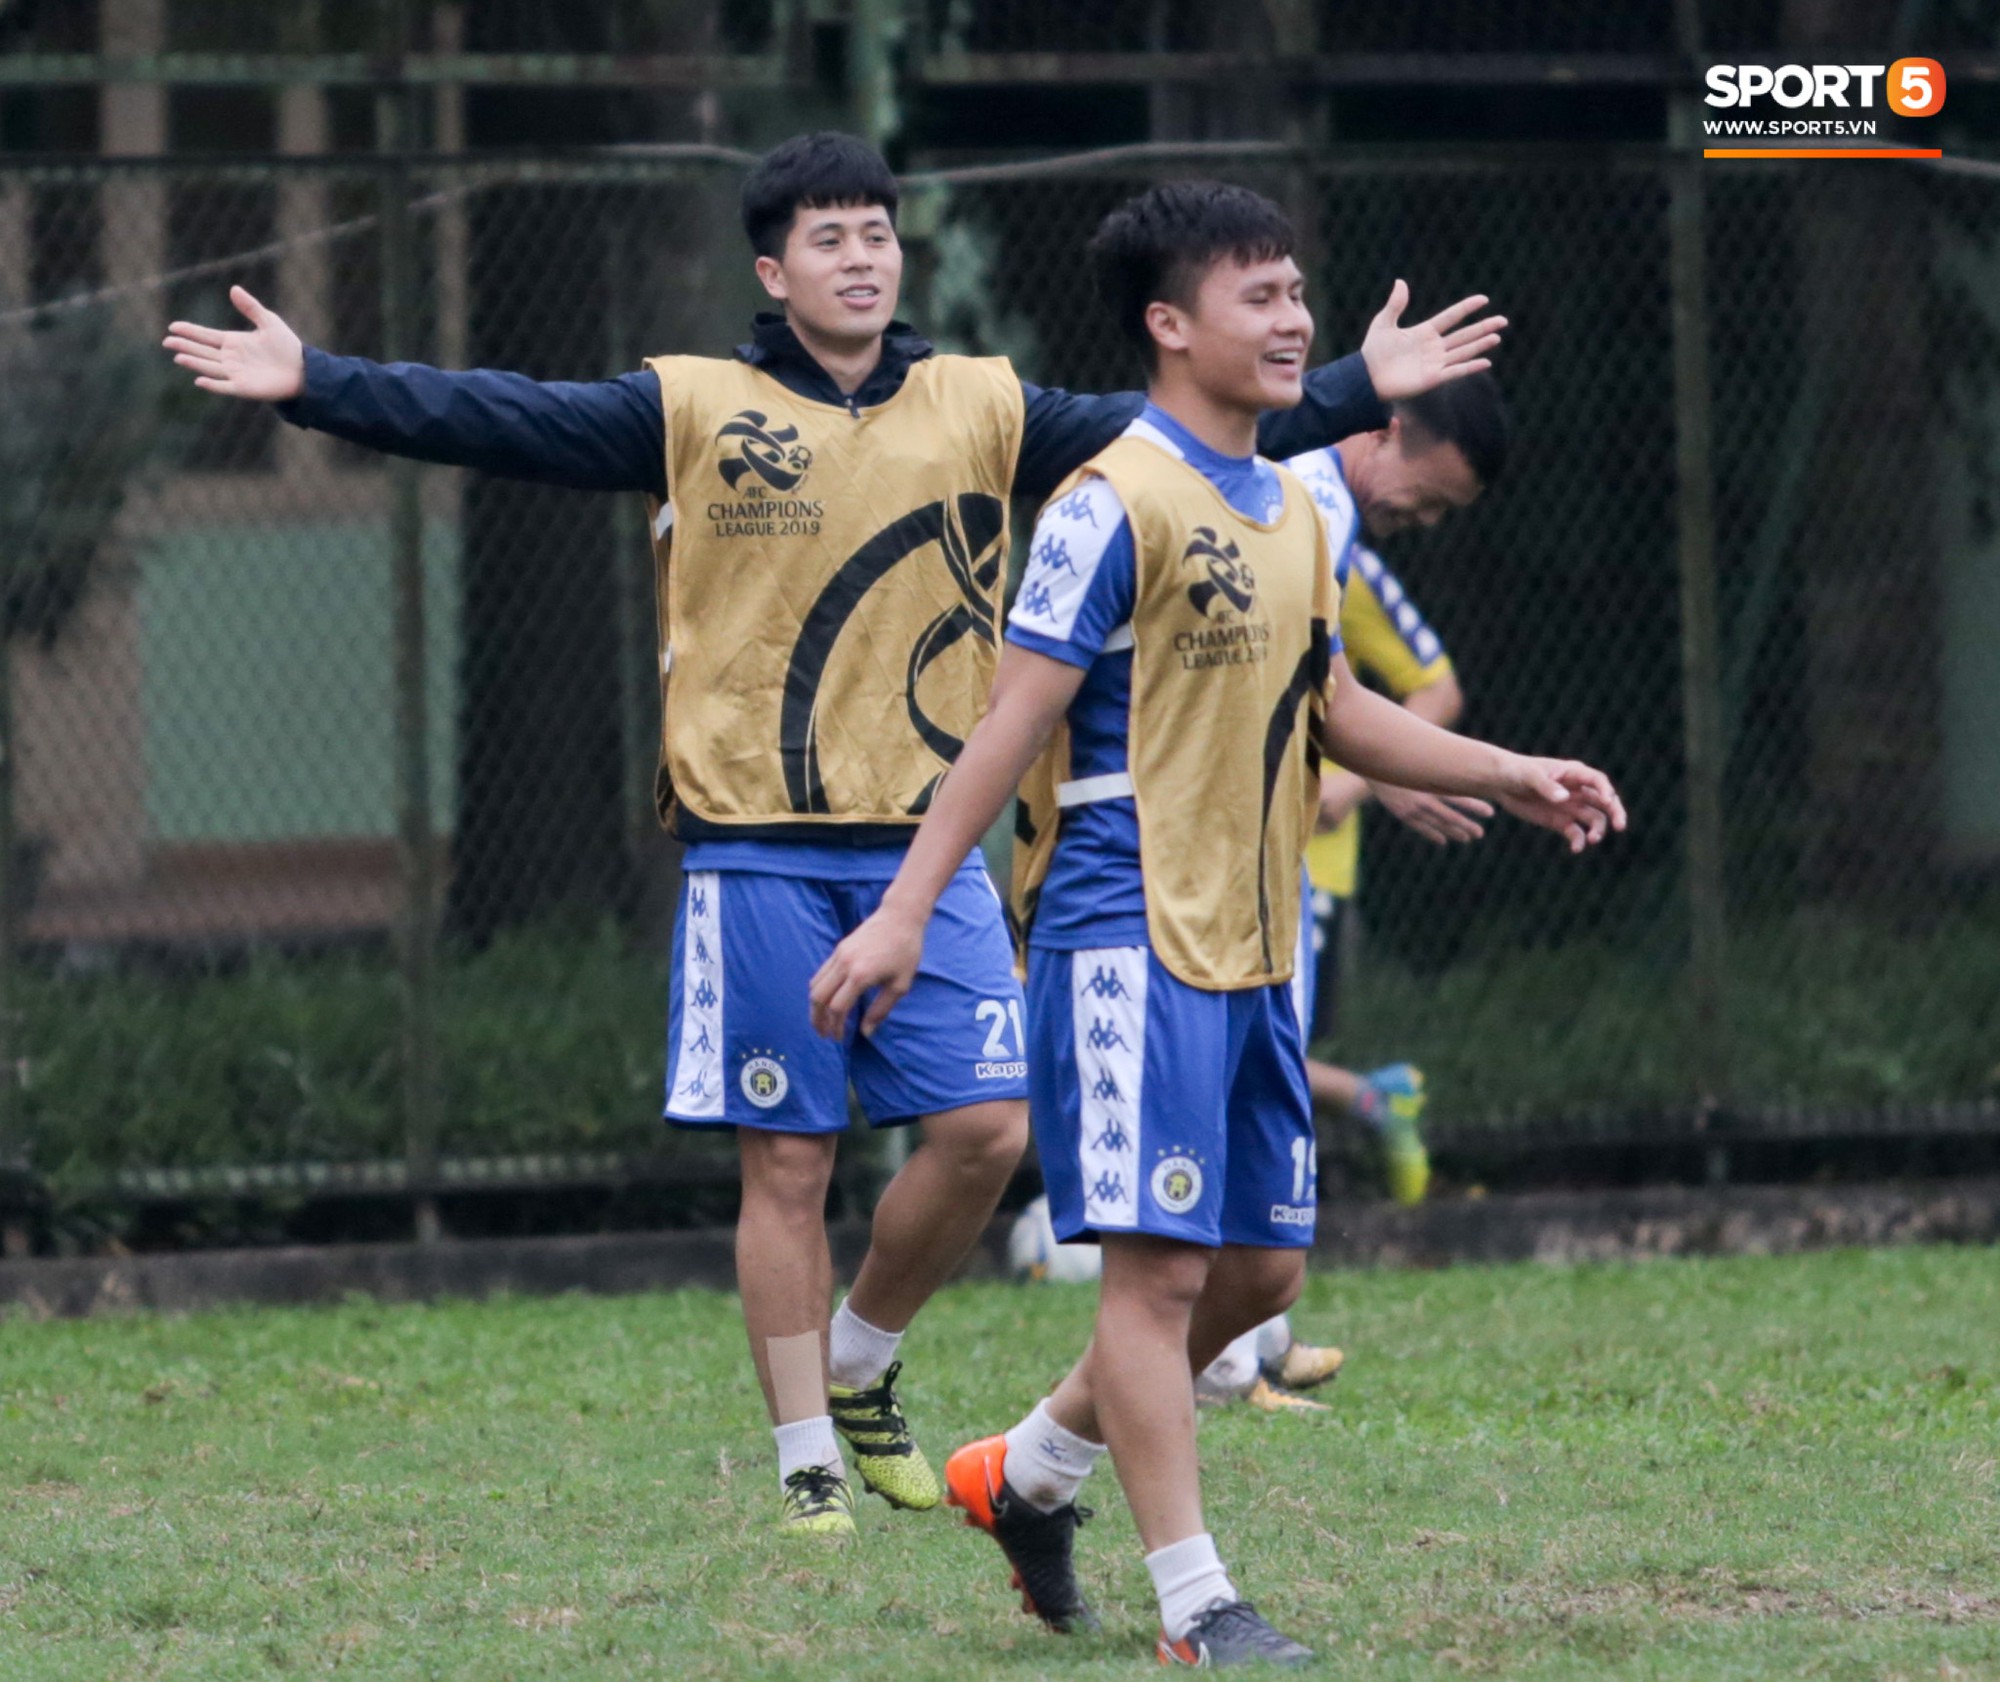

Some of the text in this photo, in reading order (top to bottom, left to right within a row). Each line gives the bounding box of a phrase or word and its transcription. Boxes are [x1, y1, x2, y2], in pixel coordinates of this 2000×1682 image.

[707, 500, 824, 520] CHAMPIONS
[715, 520, 821, 537] LEAGUE 2019
[975, 999, 1025, 1057] 21
